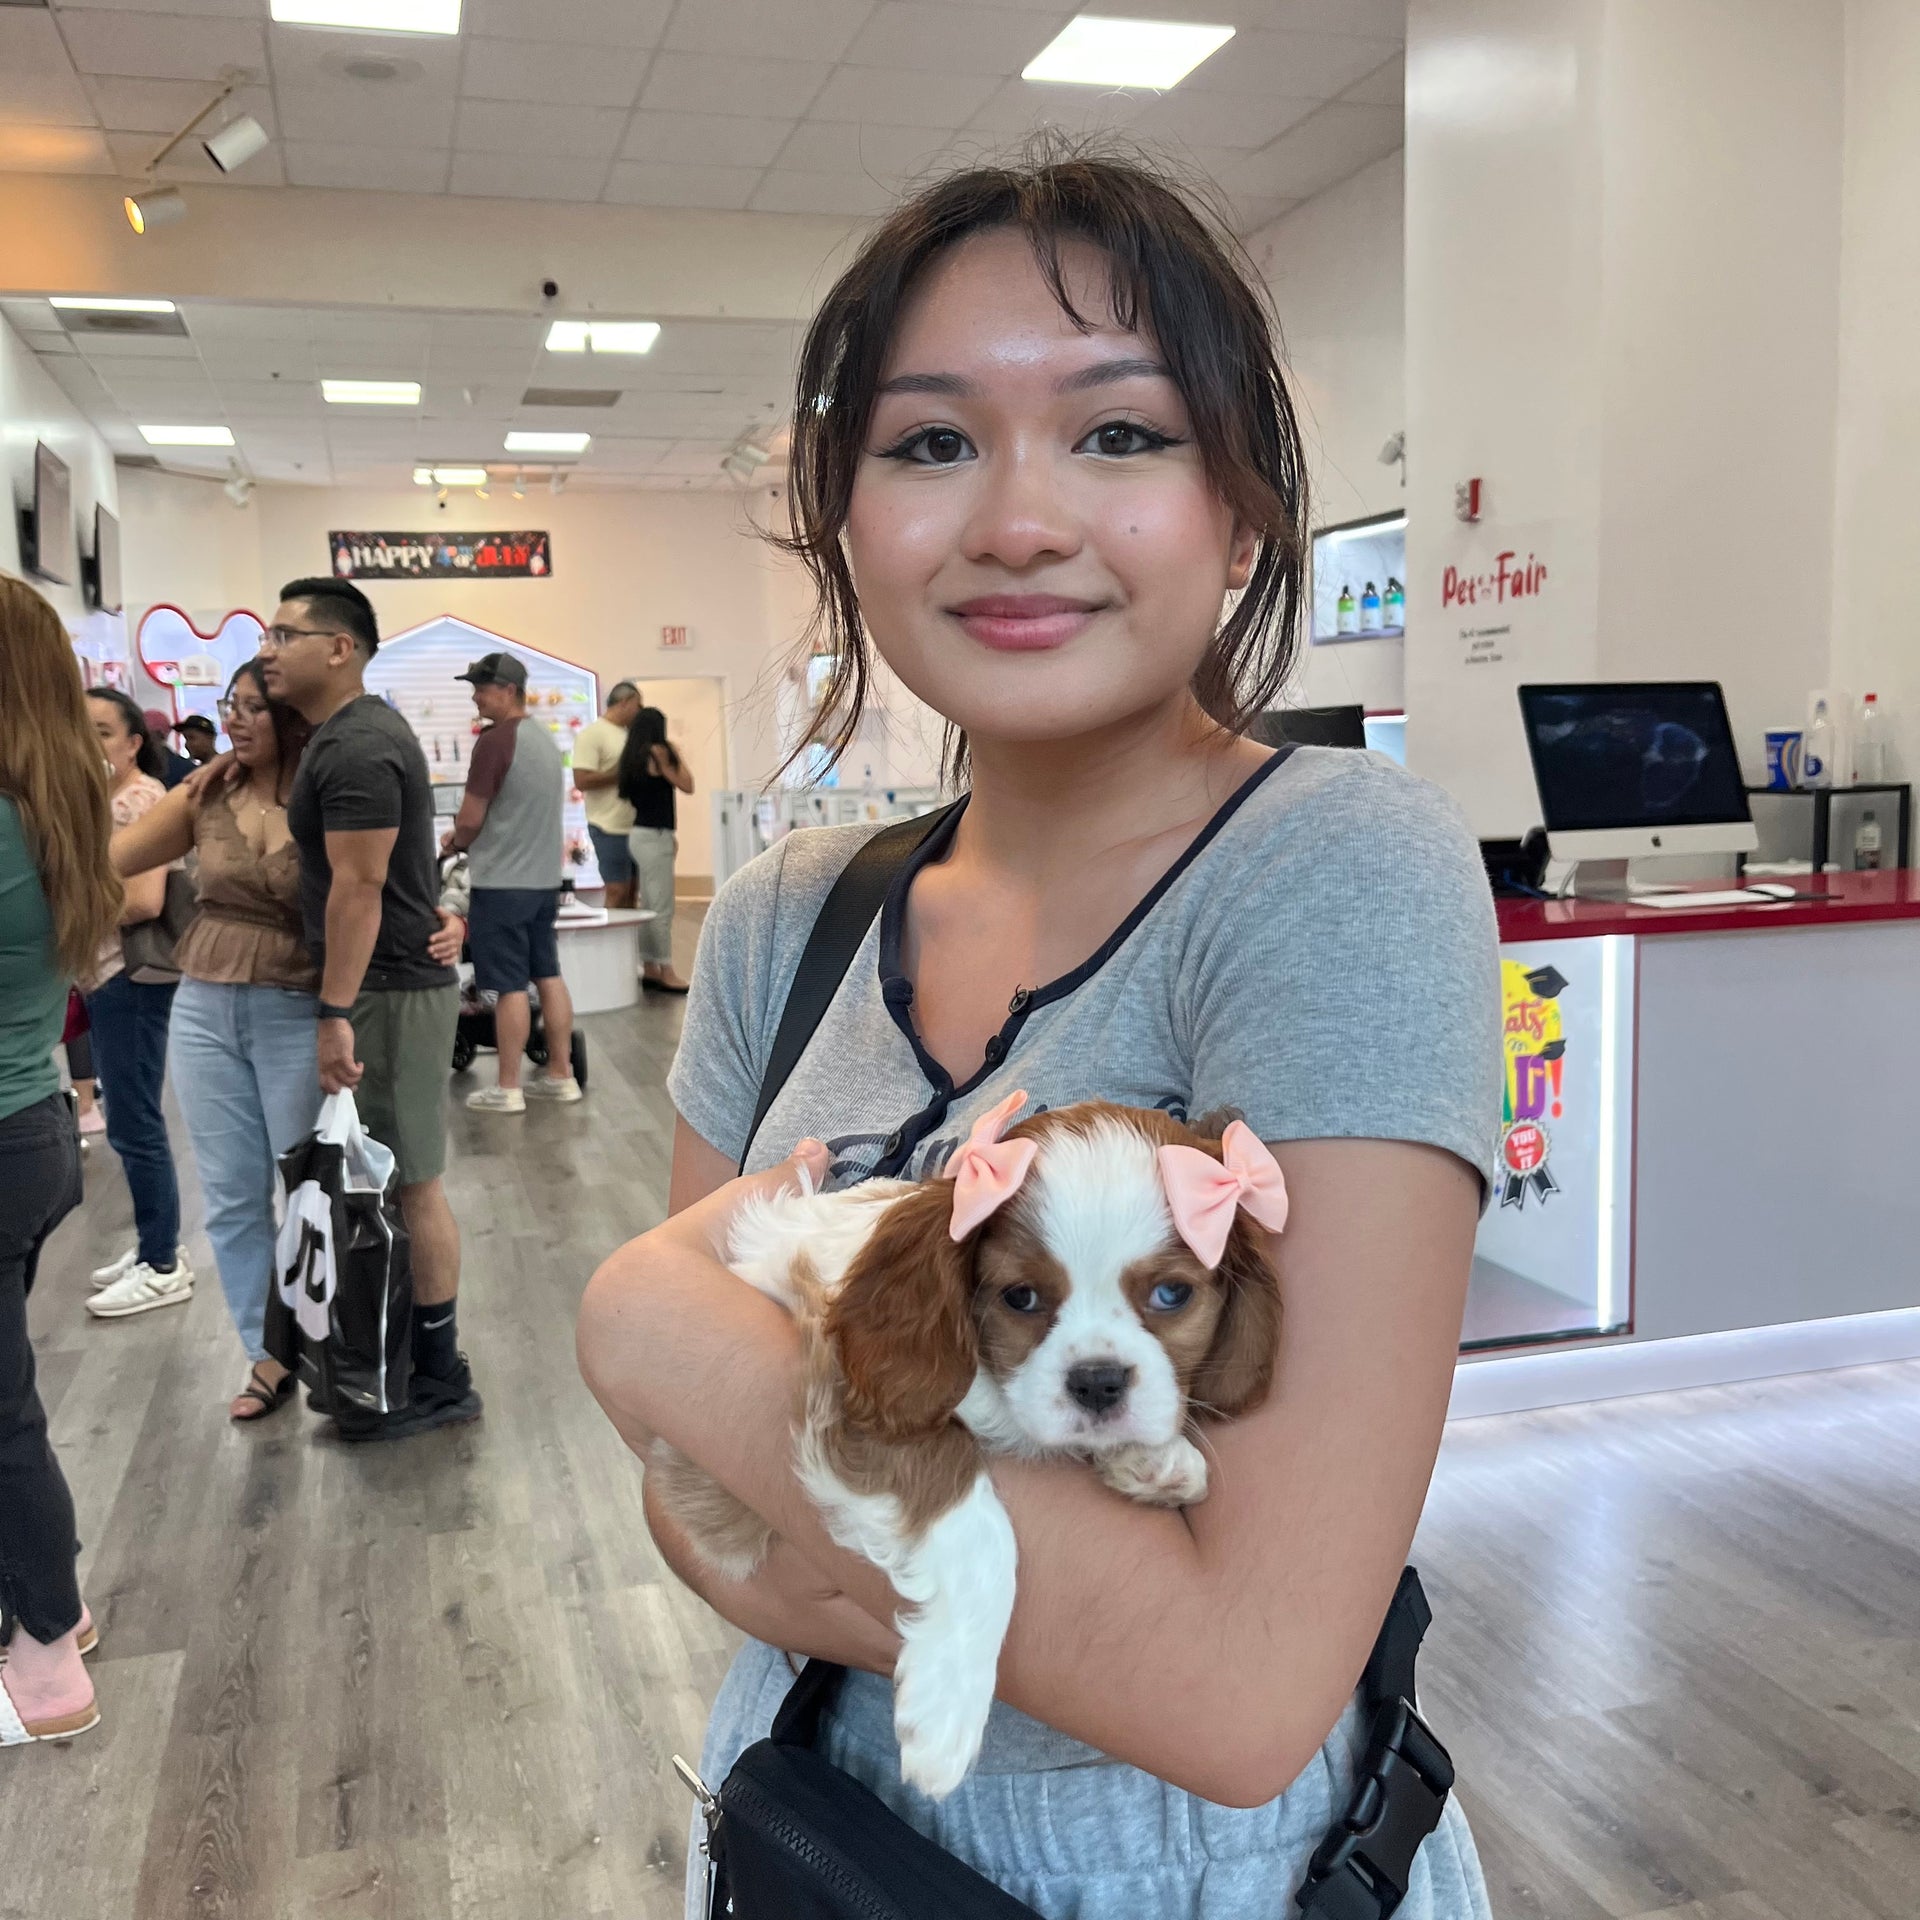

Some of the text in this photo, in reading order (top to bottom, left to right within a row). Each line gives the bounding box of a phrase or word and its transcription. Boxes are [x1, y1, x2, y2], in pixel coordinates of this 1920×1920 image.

[351, 545, 433, 568] HAPPY
[1443, 551, 1547, 608] Pet Fair
[662, 626, 687, 646] EXIT
[1505, 1001, 1546, 1040] ats
